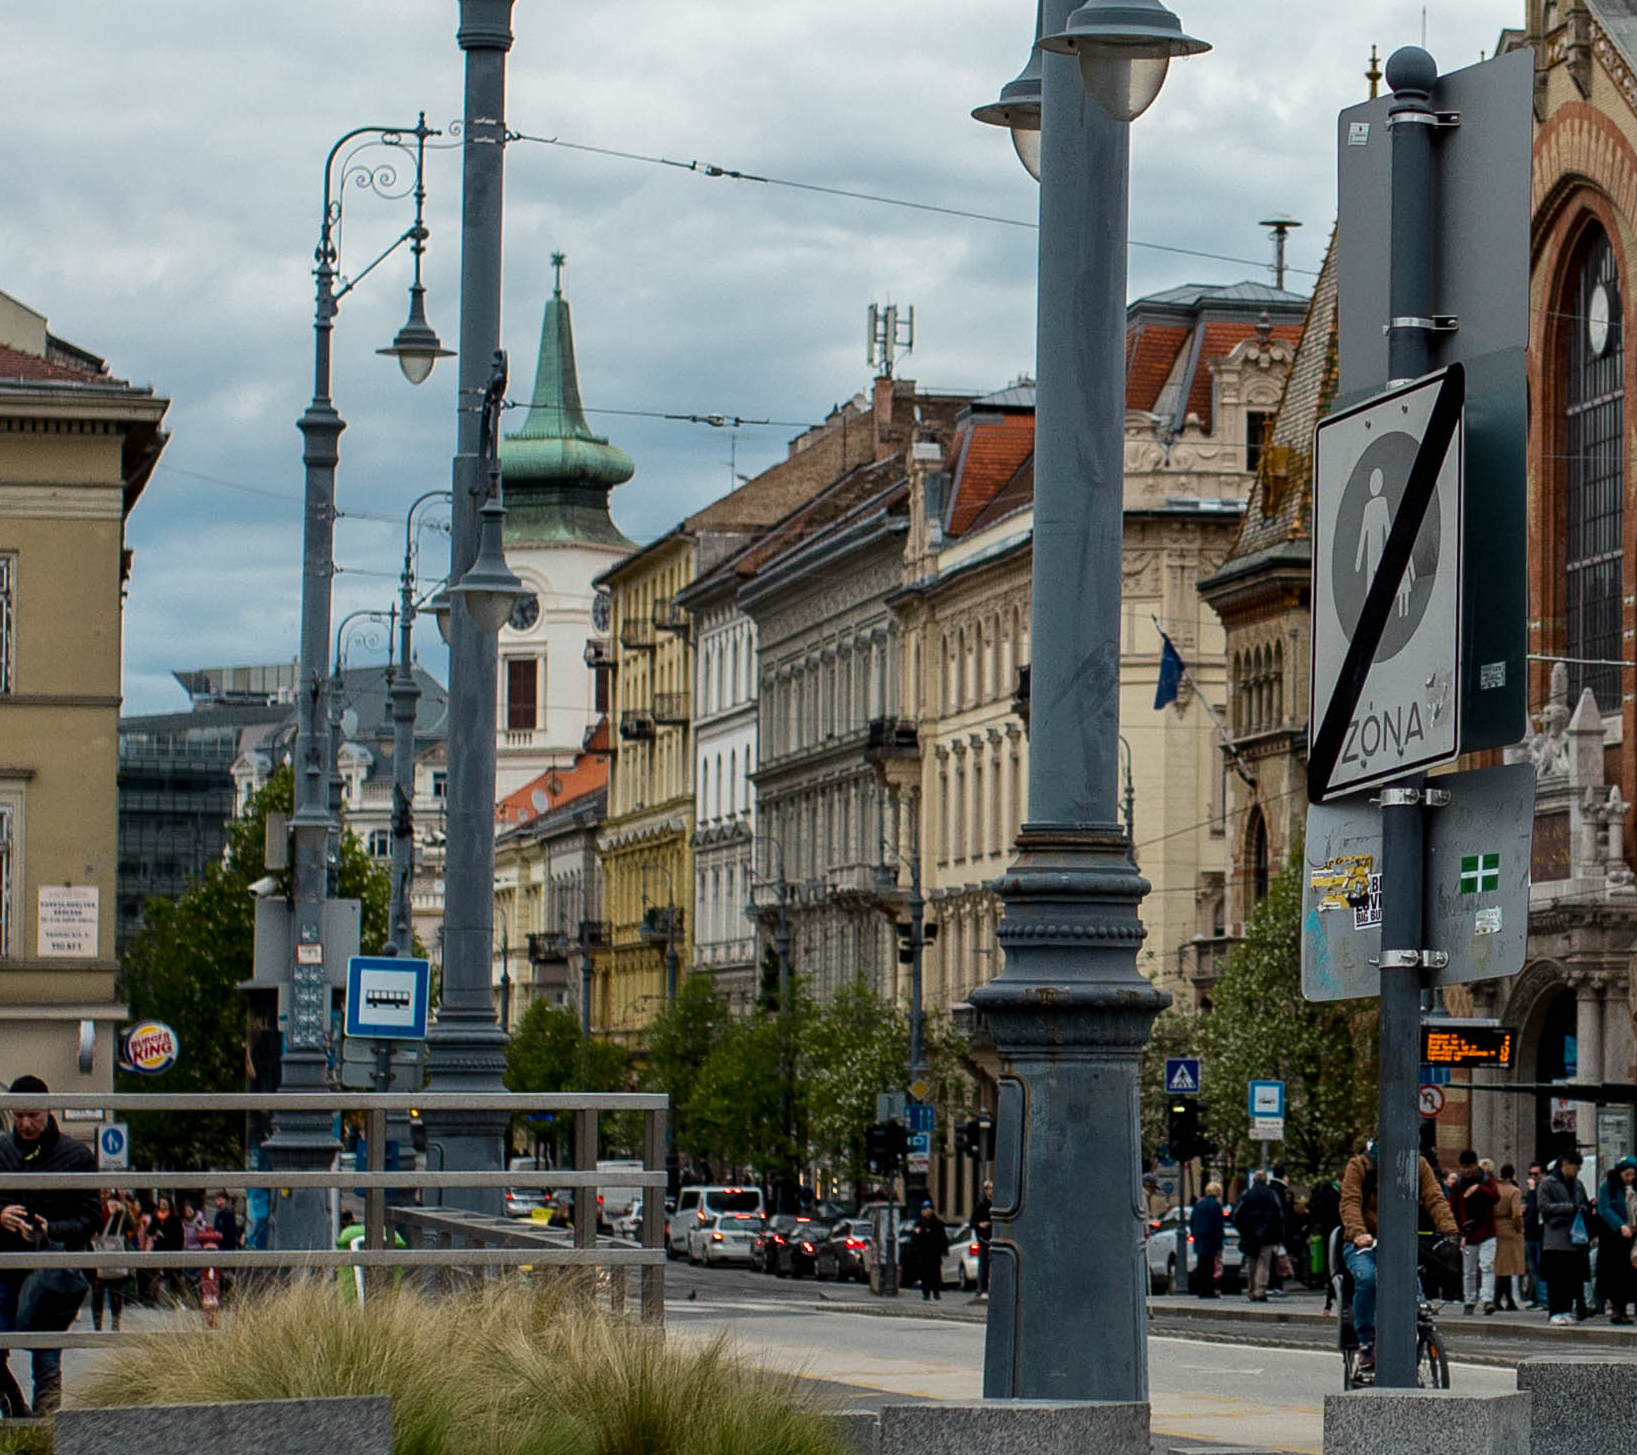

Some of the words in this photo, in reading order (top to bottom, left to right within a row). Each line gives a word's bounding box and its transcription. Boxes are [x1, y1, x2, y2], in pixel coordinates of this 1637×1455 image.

[1342, 701, 1424, 764] ZÓNA
[131, 1031, 171, 1051] BURGER
[133, 1043, 172, 1063] KING
